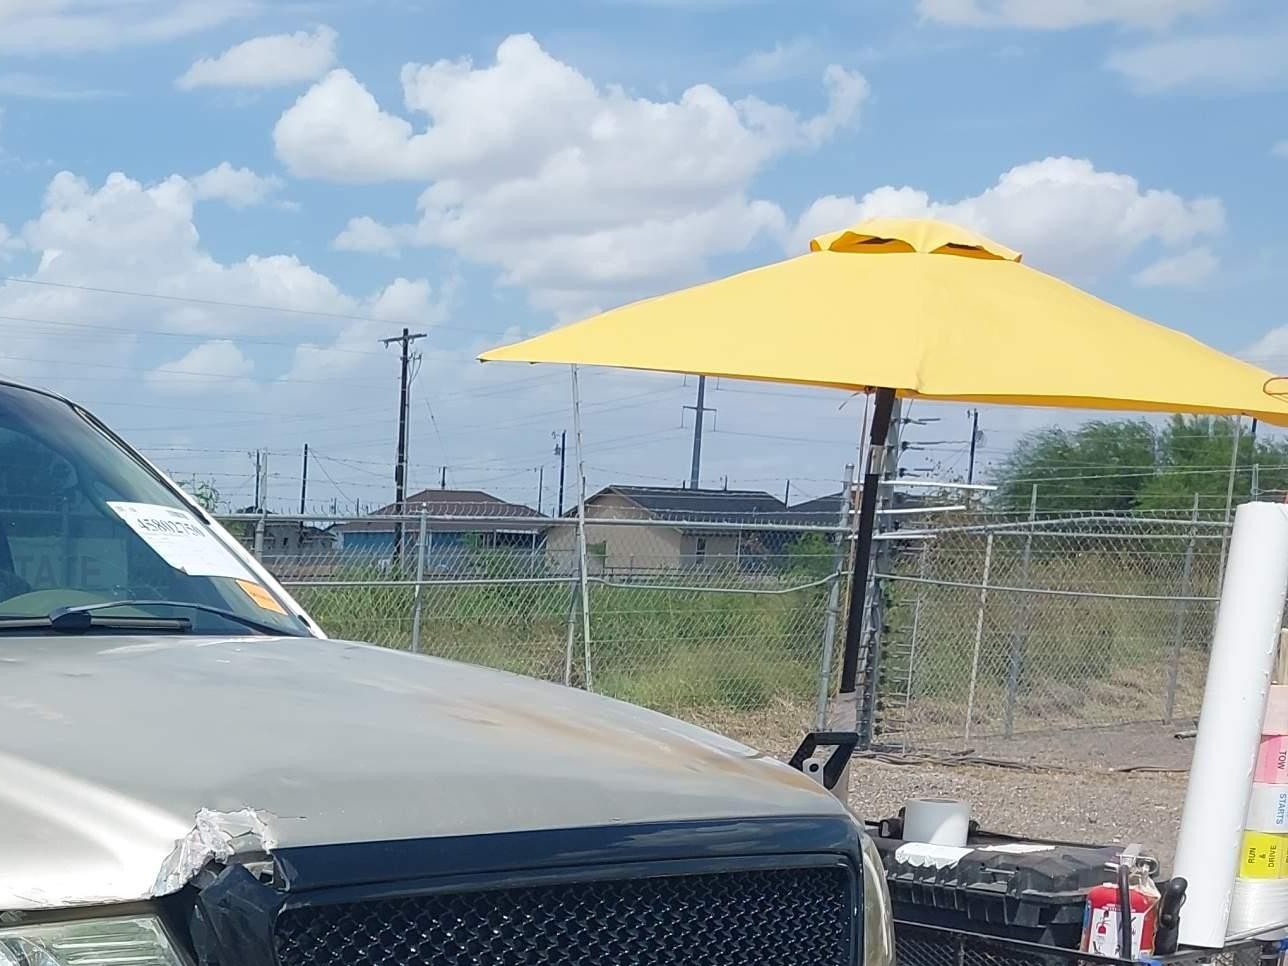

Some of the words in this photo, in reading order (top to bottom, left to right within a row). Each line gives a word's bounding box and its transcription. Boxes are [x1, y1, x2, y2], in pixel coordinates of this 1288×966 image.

[1277, 751, 1287, 770] TOW
[1276, 793, 1287, 825] STARTS
[1247, 847, 1256, 864] RUN
[1267, 845, 1277, 868] DRIVE
